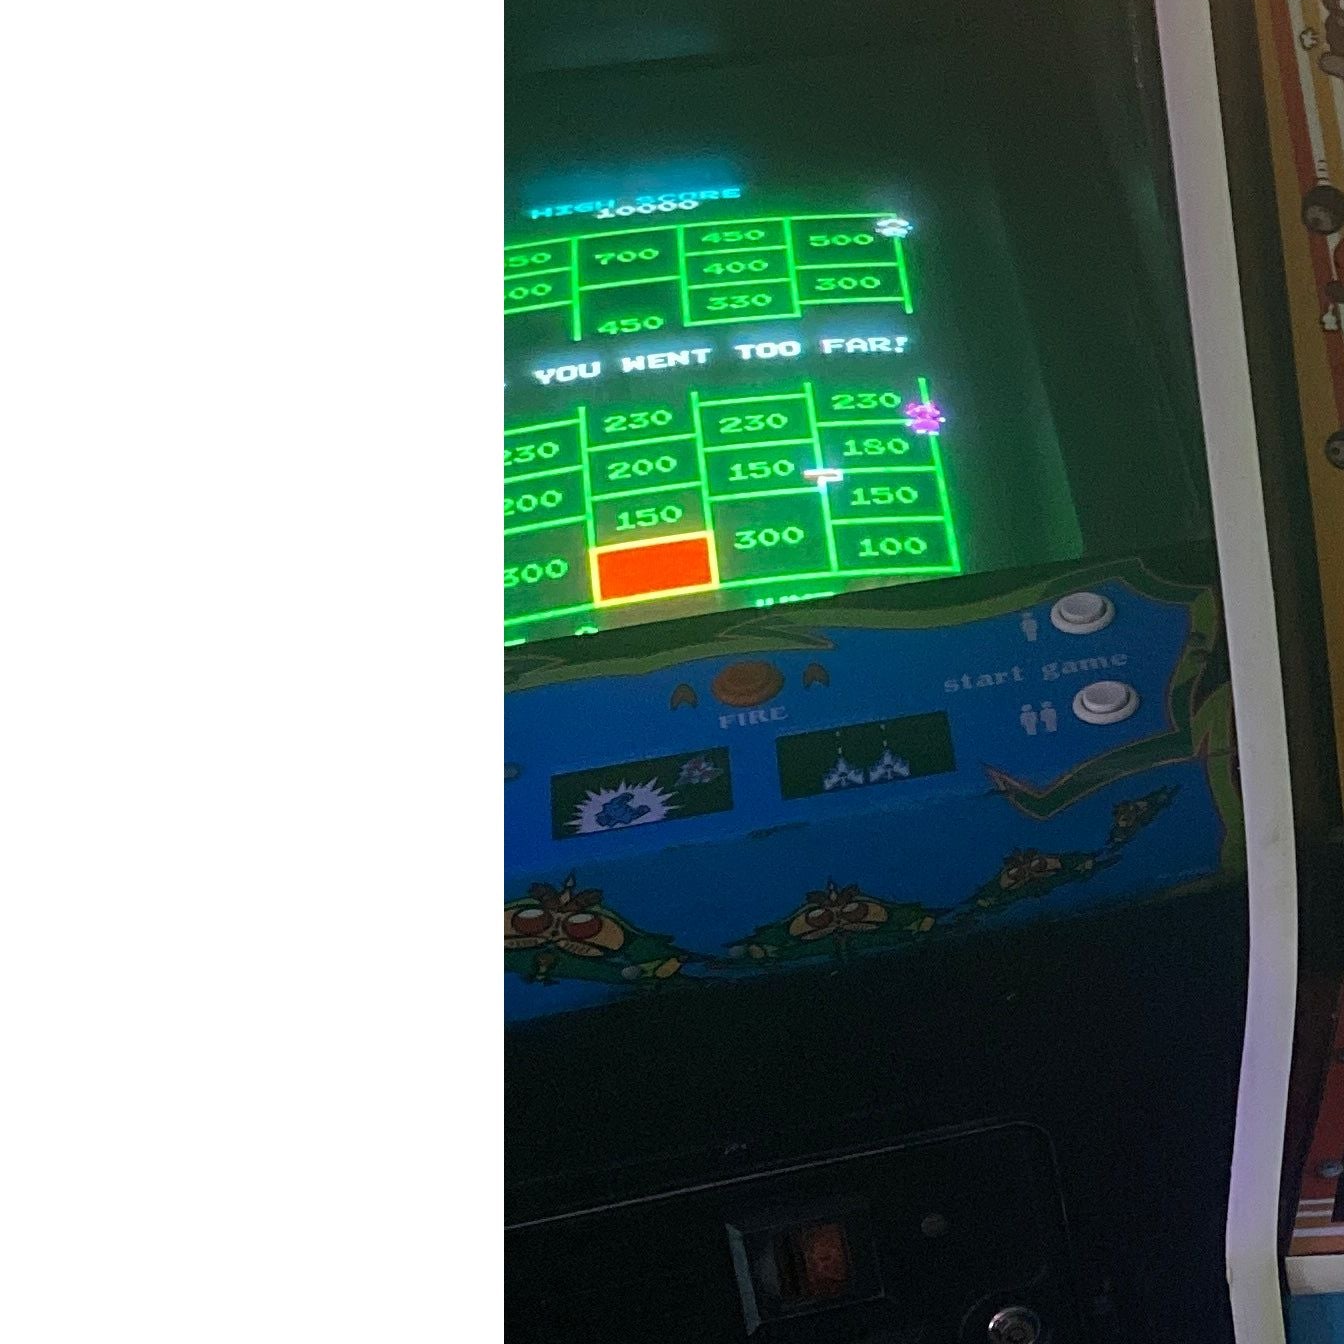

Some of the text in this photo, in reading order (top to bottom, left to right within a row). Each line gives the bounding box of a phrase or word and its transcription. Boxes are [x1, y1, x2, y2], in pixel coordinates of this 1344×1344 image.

[531, 187, 742, 219] HIGH SCORE
[597, 199, 699, 219] 10000
[701, 228, 766, 244] 450
[809, 232, 874, 248] 500
[504, 252, 552, 268] 50
[594, 248, 660, 266] 700
[703, 258, 769, 275] 400
[504, 283, 552, 300] 00
[814, 275, 881, 292] 300
[706, 293, 773, 311] 330
[597, 316, 664, 335] 450
[534, 336, 909, 385] YOU WENT TOO FAR!
[831, 391, 901, 410] 230
[604, 409, 673, 434] 230
[718, 412, 789, 435] 230
[607, 455, 678, 481] 200
[728, 459, 795, 483] 150
[850, 485, 919, 506] 150
[616, 505, 683, 531] 150
[733, 526, 805, 550] 300
[858, 536, 928, 558] 100
[943, 653, 1129, 693] start game
[718, 705, 788, 730] FIRE
